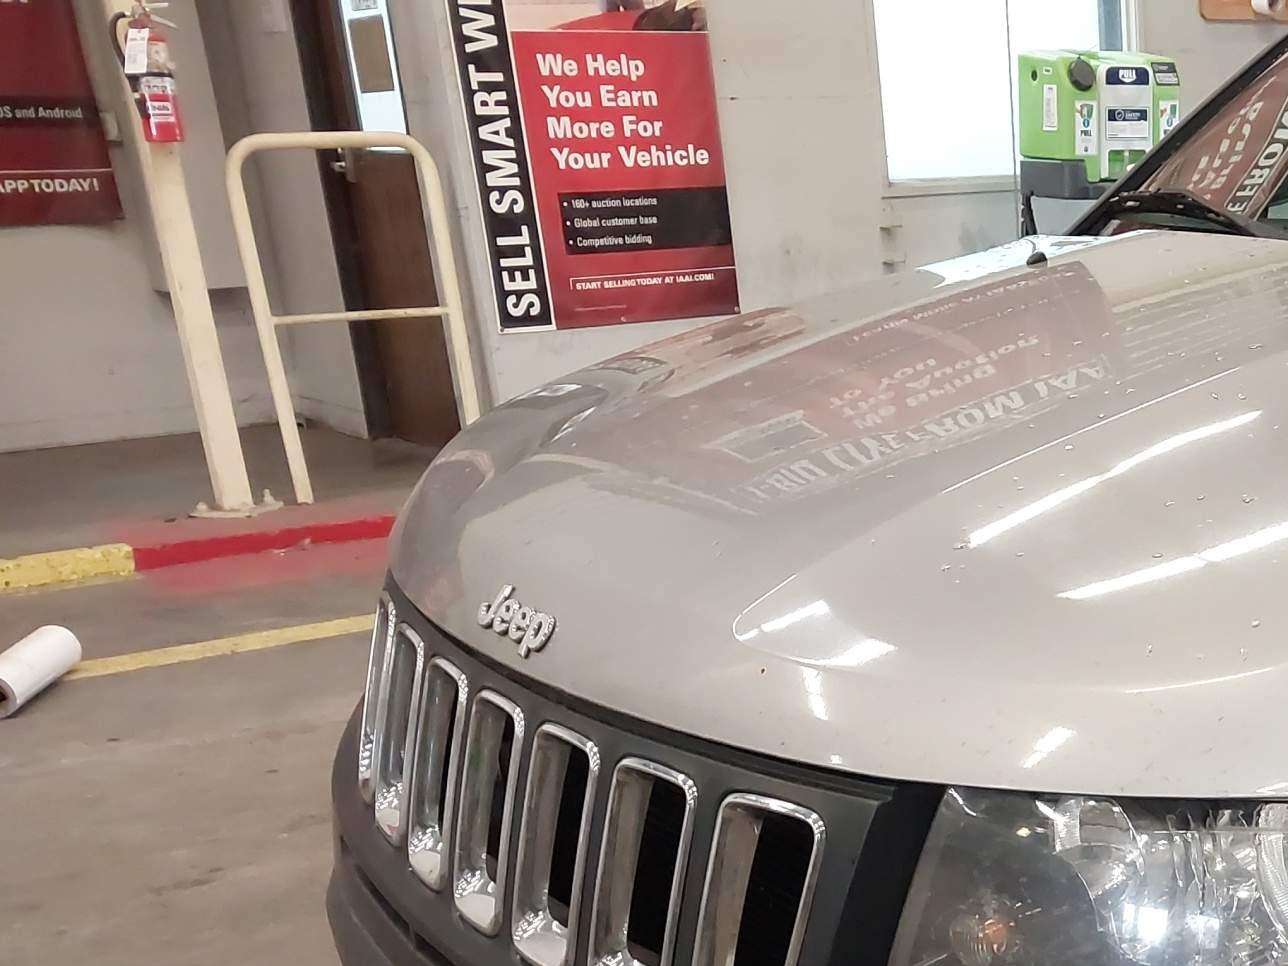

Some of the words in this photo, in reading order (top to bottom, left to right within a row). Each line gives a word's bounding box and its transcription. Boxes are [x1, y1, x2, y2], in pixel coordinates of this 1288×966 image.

[536, 53, 578, 76] We
[585, 53, 645, 81] Help
[541, 85, 592, 107] You
[600, 84, 658, 107] Earn
[15, 107, 35, 118] and
[38, 107, 83, 118] Android
[547, 116, 615, 139] More
[622, 115, 663, 137] For
[468, 64, 525, 214] SMART
[550, 147, 611, 169] Your
[617, 144, 710, 168] Vehicle
[29, 178, 99, 192] TODAY!
[591, 198, 622, 208] auction
[622, 196, 658, 207] locations
[574, 217, 600, 228] Global
[601, 217, 638, 227] customer
[639, 215, 658, 225] base
[576, 235, 624, 248] Competitive
[625, 234, 652, 245] bidding
[496, 225, 542, 317] SELL
[575, 281, 602, 290] START
[603, 279, 636, 289] SELLING
[636, 277, 662, 286] TODAY
[664, 276, 674, 284] AT
[477, 584, 557, 659] Jeep
